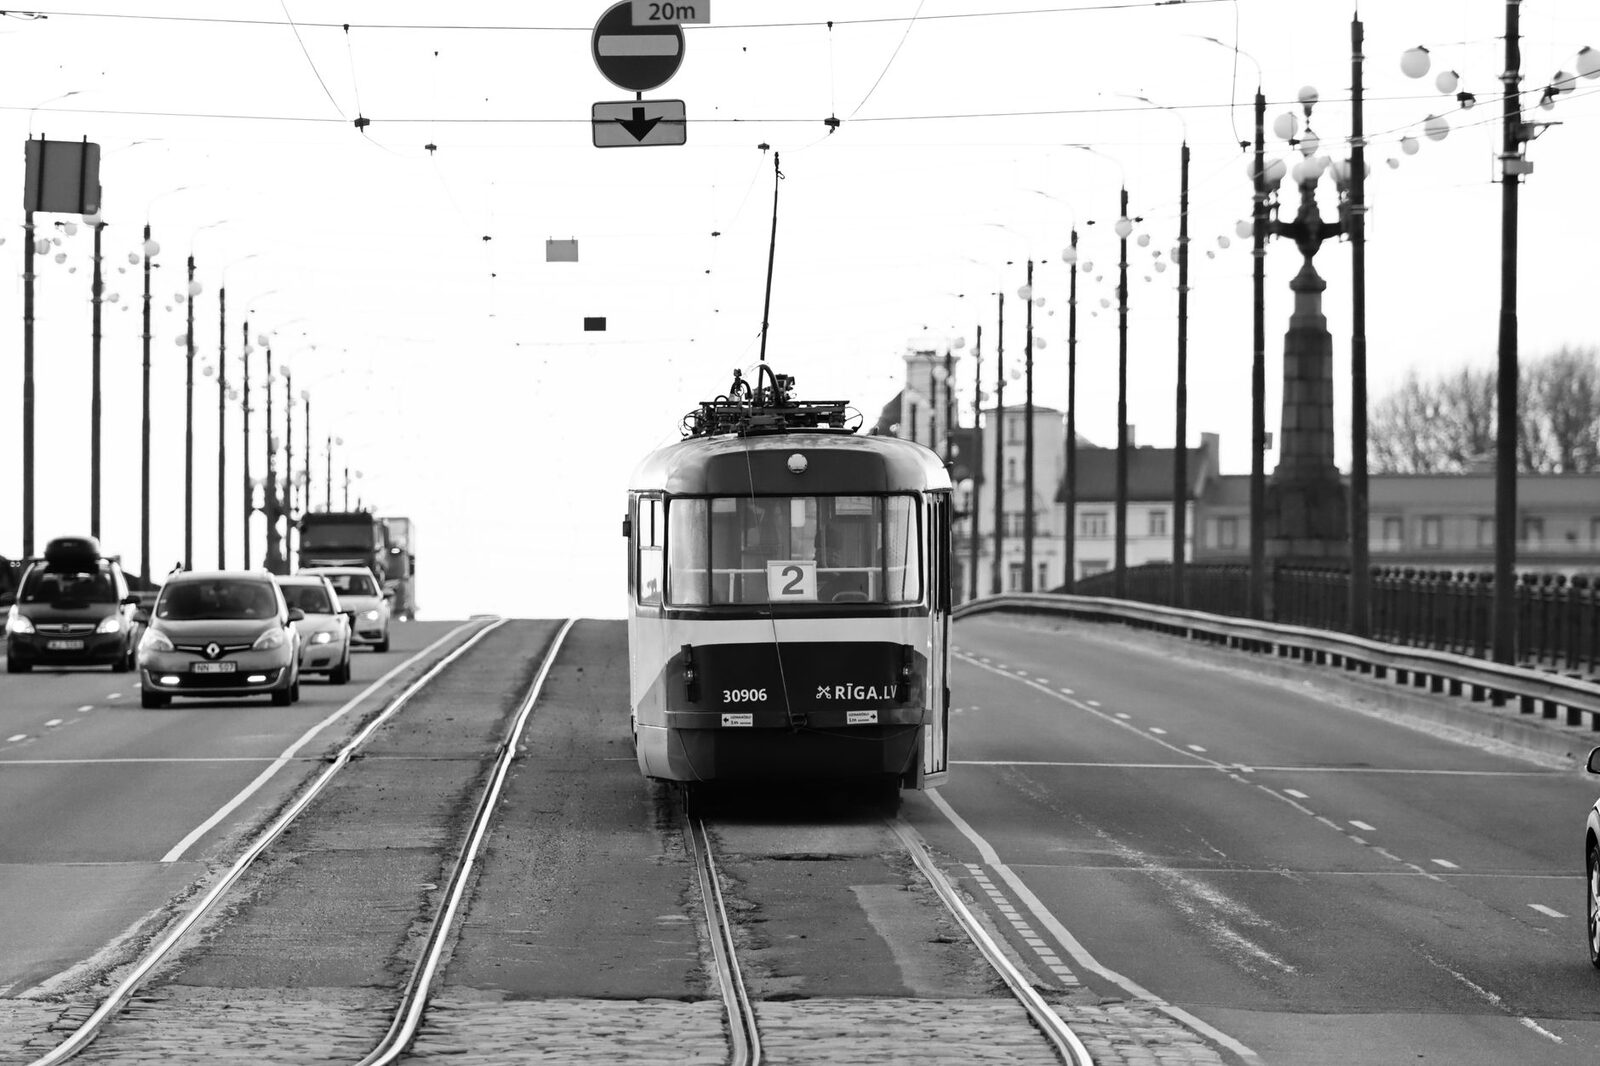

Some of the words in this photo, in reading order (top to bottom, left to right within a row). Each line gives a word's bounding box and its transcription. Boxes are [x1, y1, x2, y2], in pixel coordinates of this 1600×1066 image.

[648, 2, 695, 20] 20m
[781, 565, 804, 595] 2
[723, 688, 768, 703] 30906
[835, 682, 897, 700] RĪGA.LV
